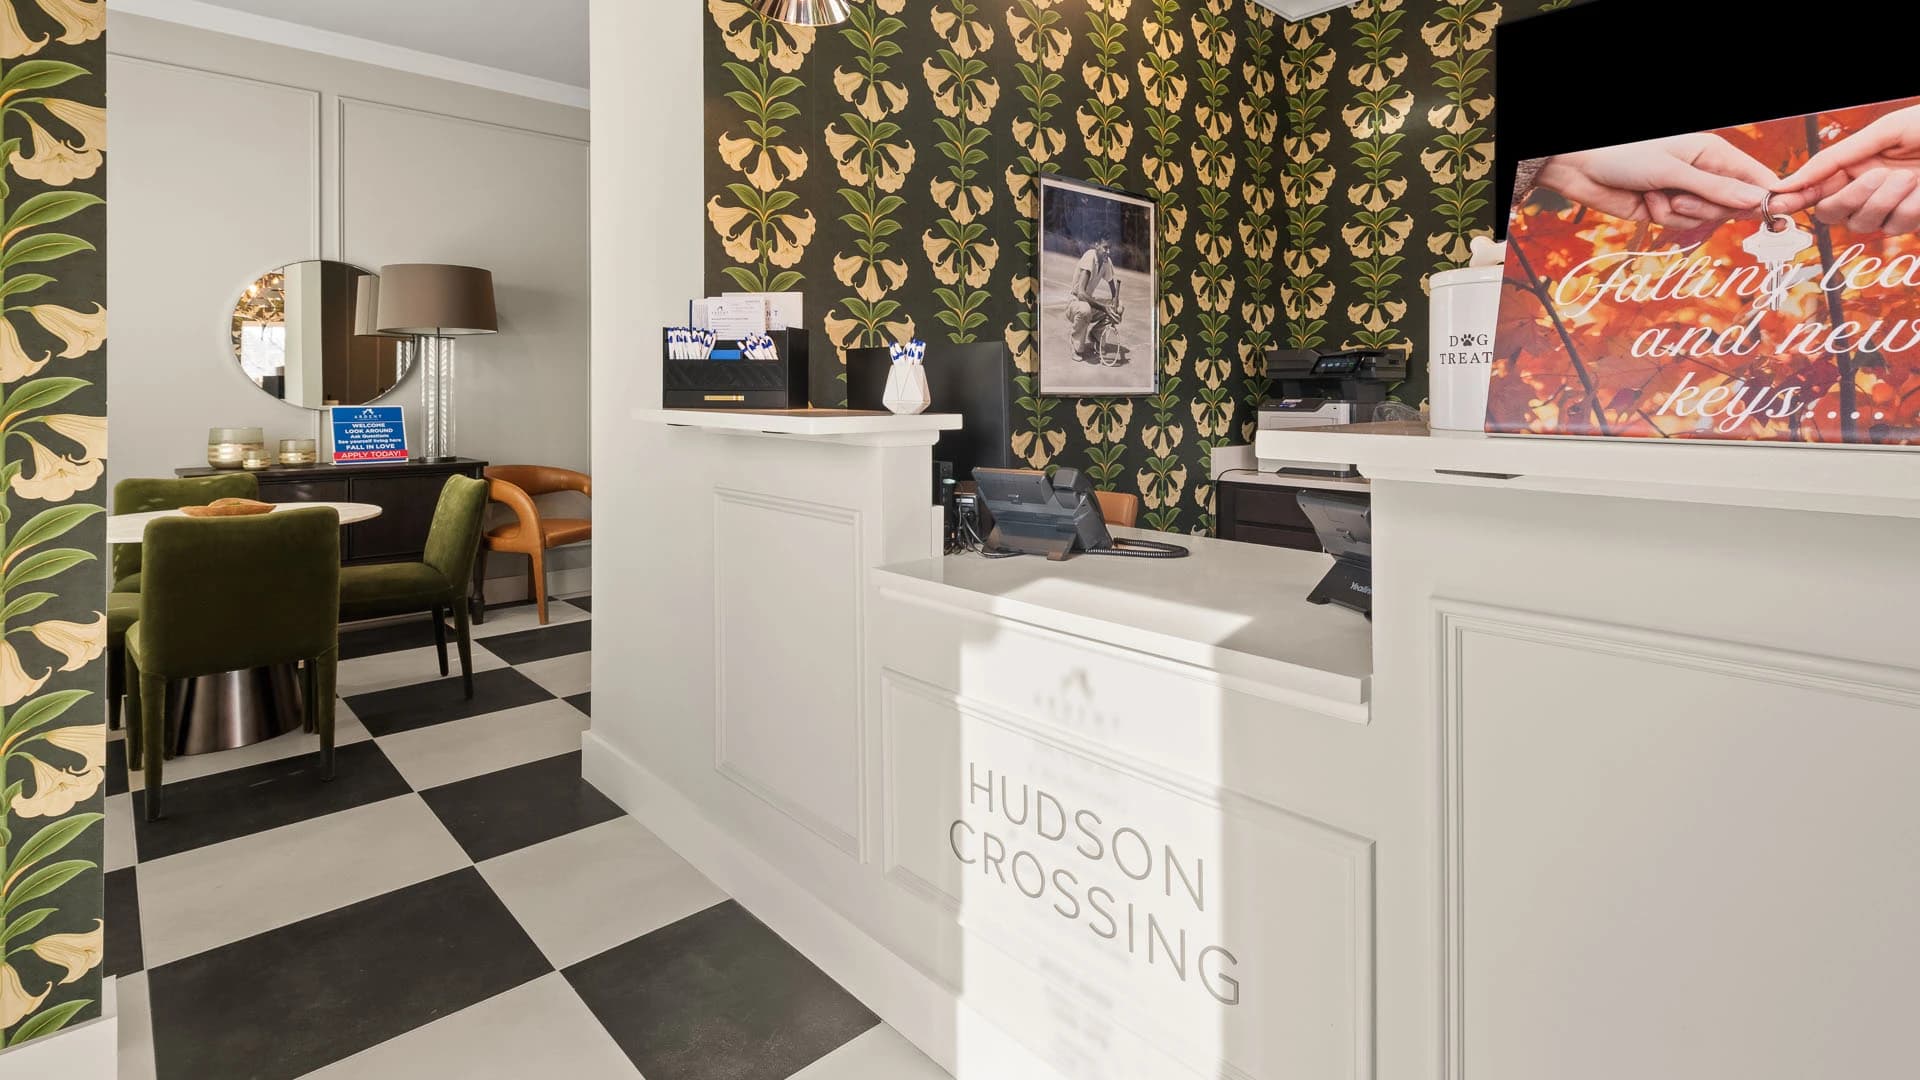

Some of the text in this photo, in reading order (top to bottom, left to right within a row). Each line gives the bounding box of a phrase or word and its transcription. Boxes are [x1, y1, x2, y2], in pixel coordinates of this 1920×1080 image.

[1555, 241, 1803, 318] Falling
[1449, 333, 1489, 347] DG
[1631, 310, 1920, 358] and new
[969, 762, 1204, 912] HUDSON
[949, 818, 1240, 1005] CROSSING
